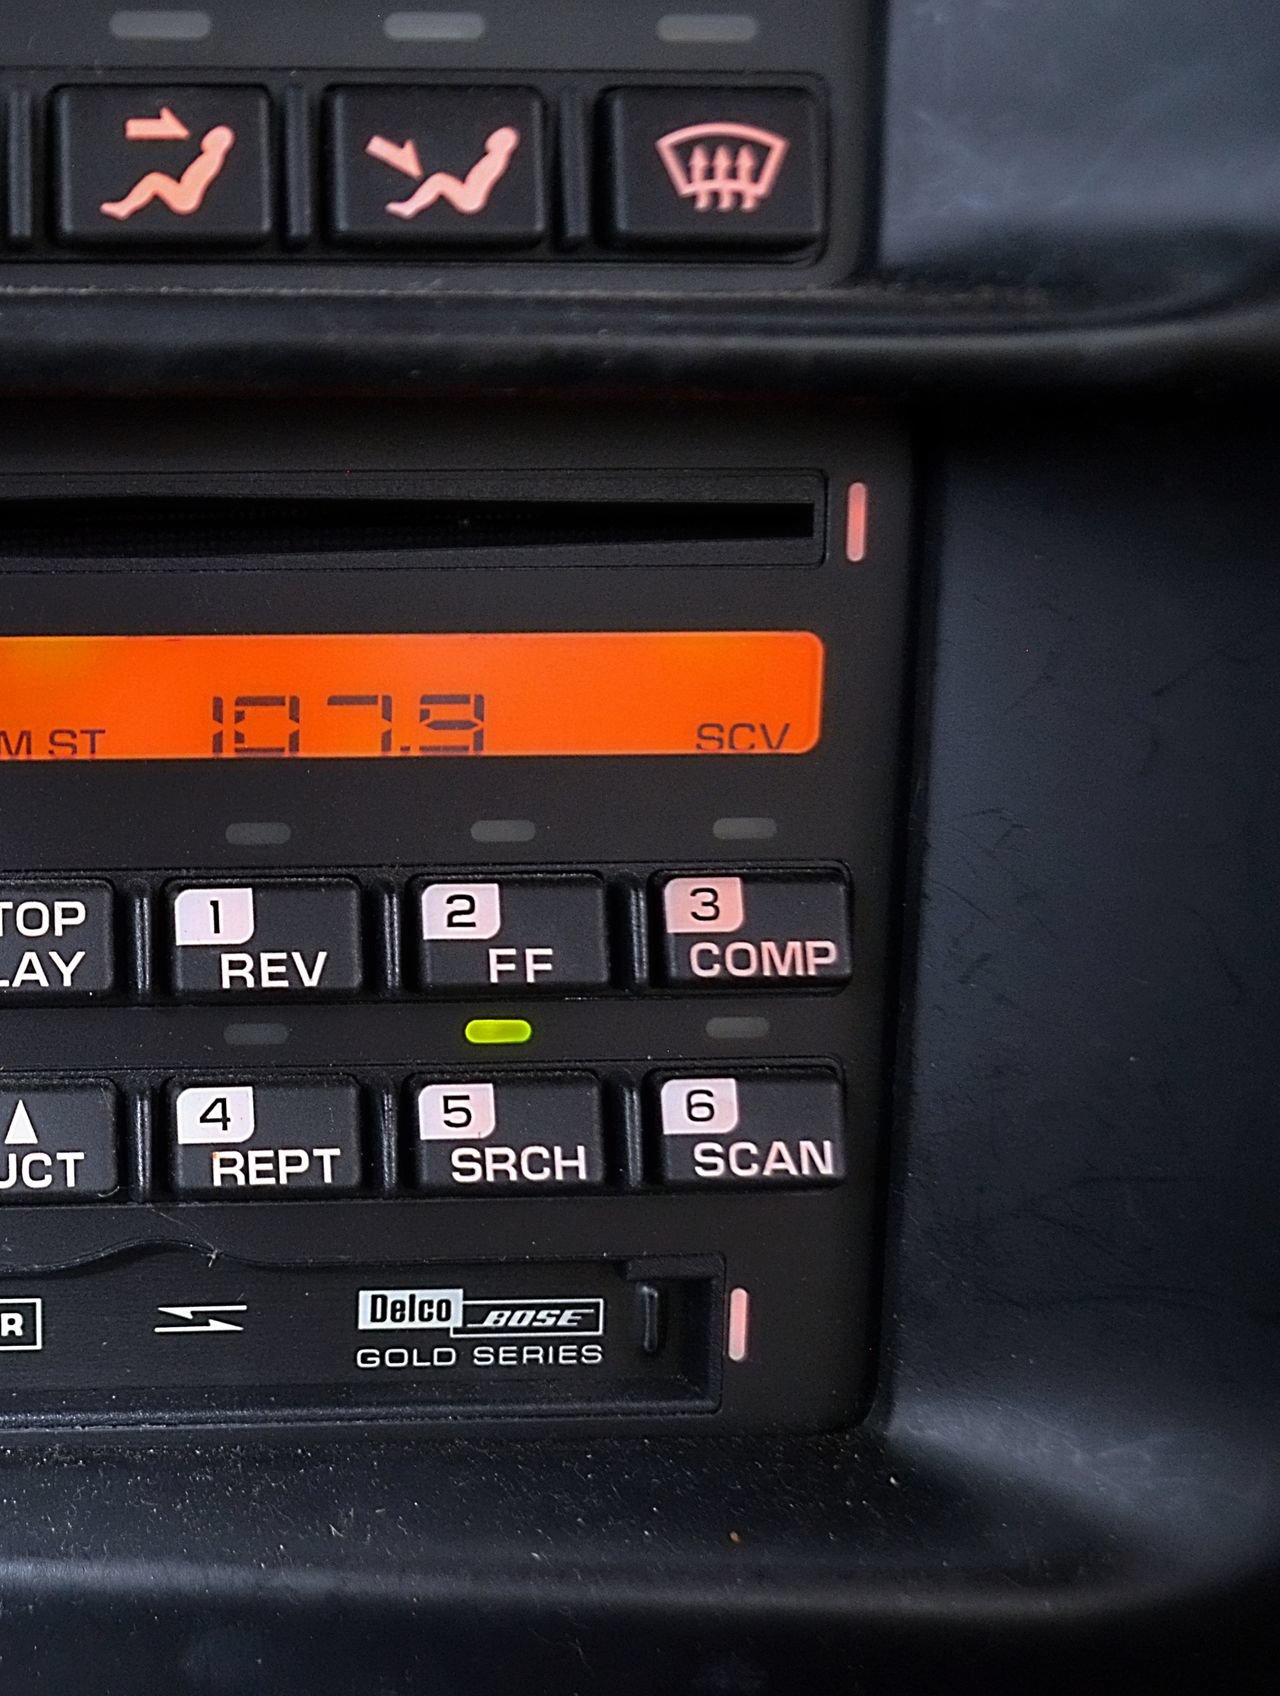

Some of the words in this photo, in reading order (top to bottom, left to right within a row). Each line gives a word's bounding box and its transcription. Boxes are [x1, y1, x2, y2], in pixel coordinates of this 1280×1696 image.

[212, 694, 485, 754] 107.9
[696, 723, 791, 751] SCV
[48, 729, 106, 756] ST
[208, 899, 222, 935] 1
[445, 893, 477, 929] 2
[689, 887, 721, 922] 3
[220, 951, 328, 989] REV
[488, 947, 554, 984] FF
[688, 939, 838, 978] COMP
[198, 1097, 232, 1132] 4
[442, 1094, 473, 1129] 5
[685, 1089, 716, 1123] 6
[211, 1147, 342, 1187] REPT
[450, 1144, 588, 1183] SRCH
[692, 1139, 834, 1178] SCAN
[369, 1293, 453, 1323] Delco
[466, 1308, 596, 1328] BOSE
[355, 1347, 458, 1369] GOLD
[472, 1344, 604, 1366] SERIES
